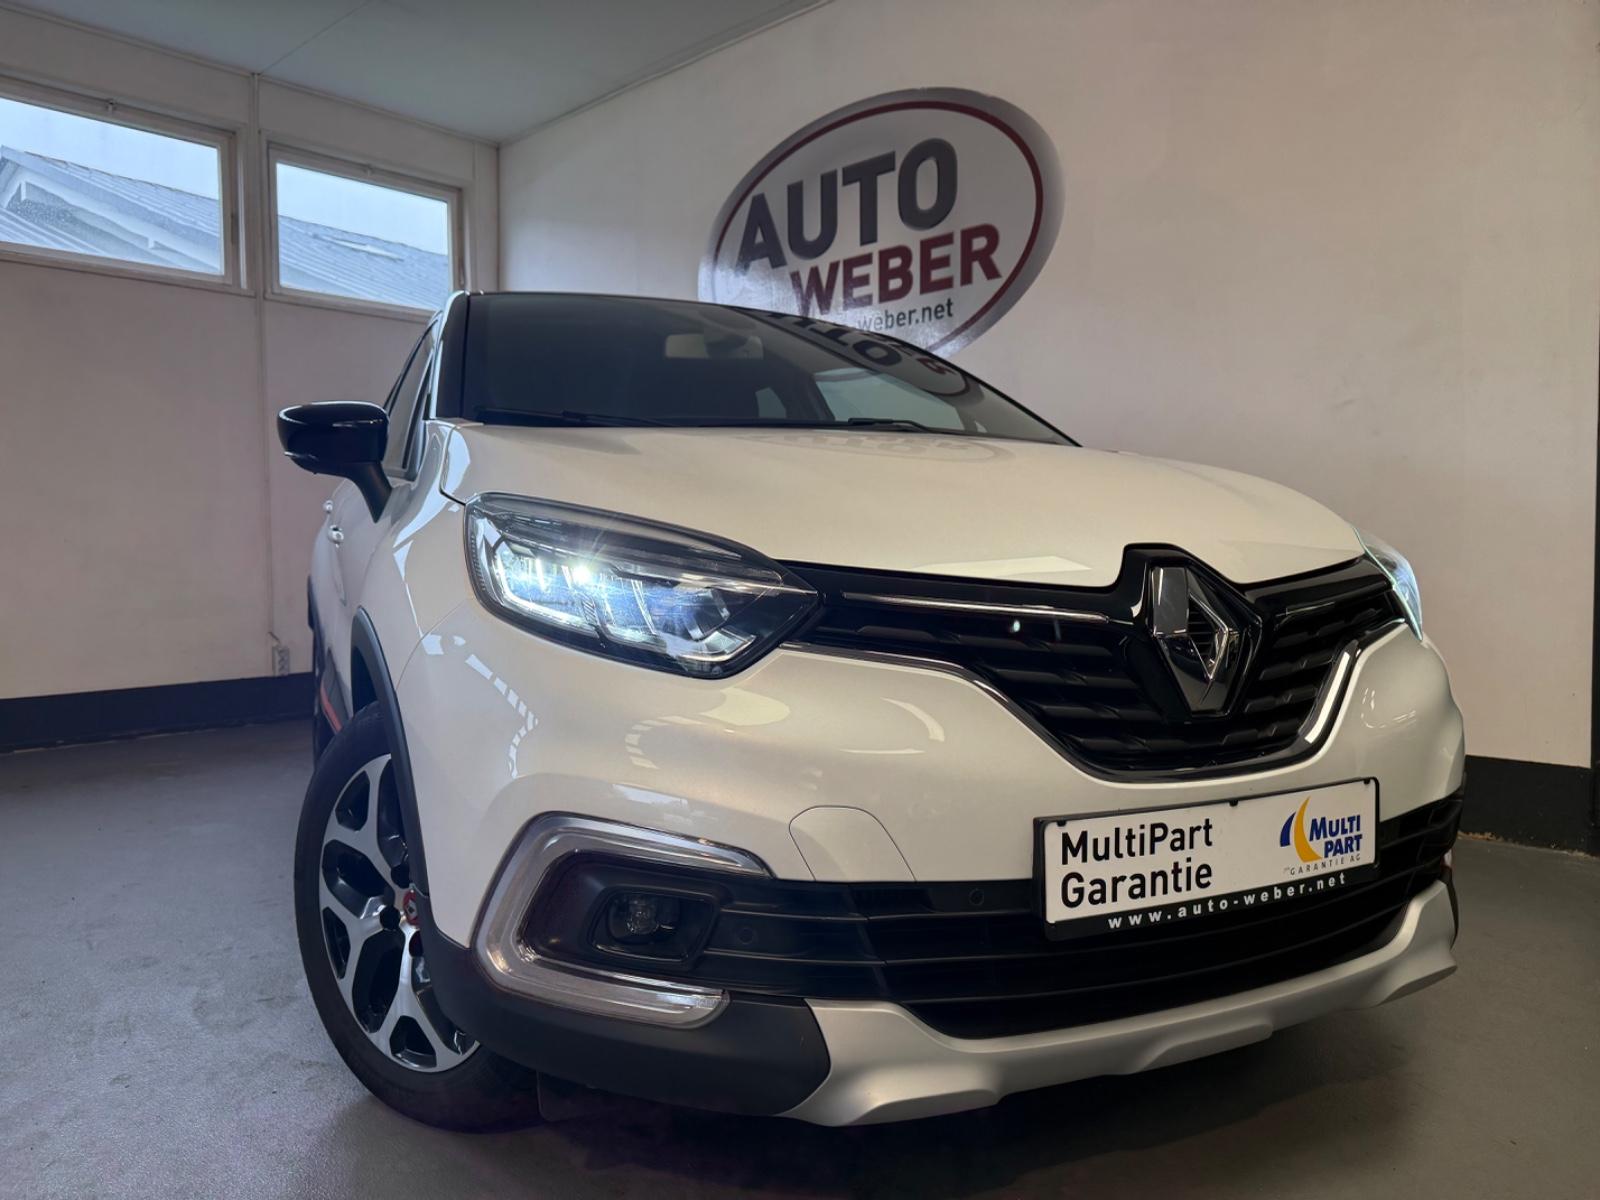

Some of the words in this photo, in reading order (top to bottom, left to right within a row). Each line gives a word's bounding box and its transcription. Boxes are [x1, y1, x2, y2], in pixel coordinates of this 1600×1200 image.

[735, 138, 958, 276] AUTO
[790, 223, 1003, 318] WEBER
[1061, 818, 1213, 865] MultiPart
[1309, 814, 1361, 842] MULTI
[1323, 834, 1363, 859] PART
[1061, 857, 1213, 908] Garantie
[1290, 858, 1345, 876] GARANTIE
[1107, 872, 1346, 929] www.auto-weber.net
